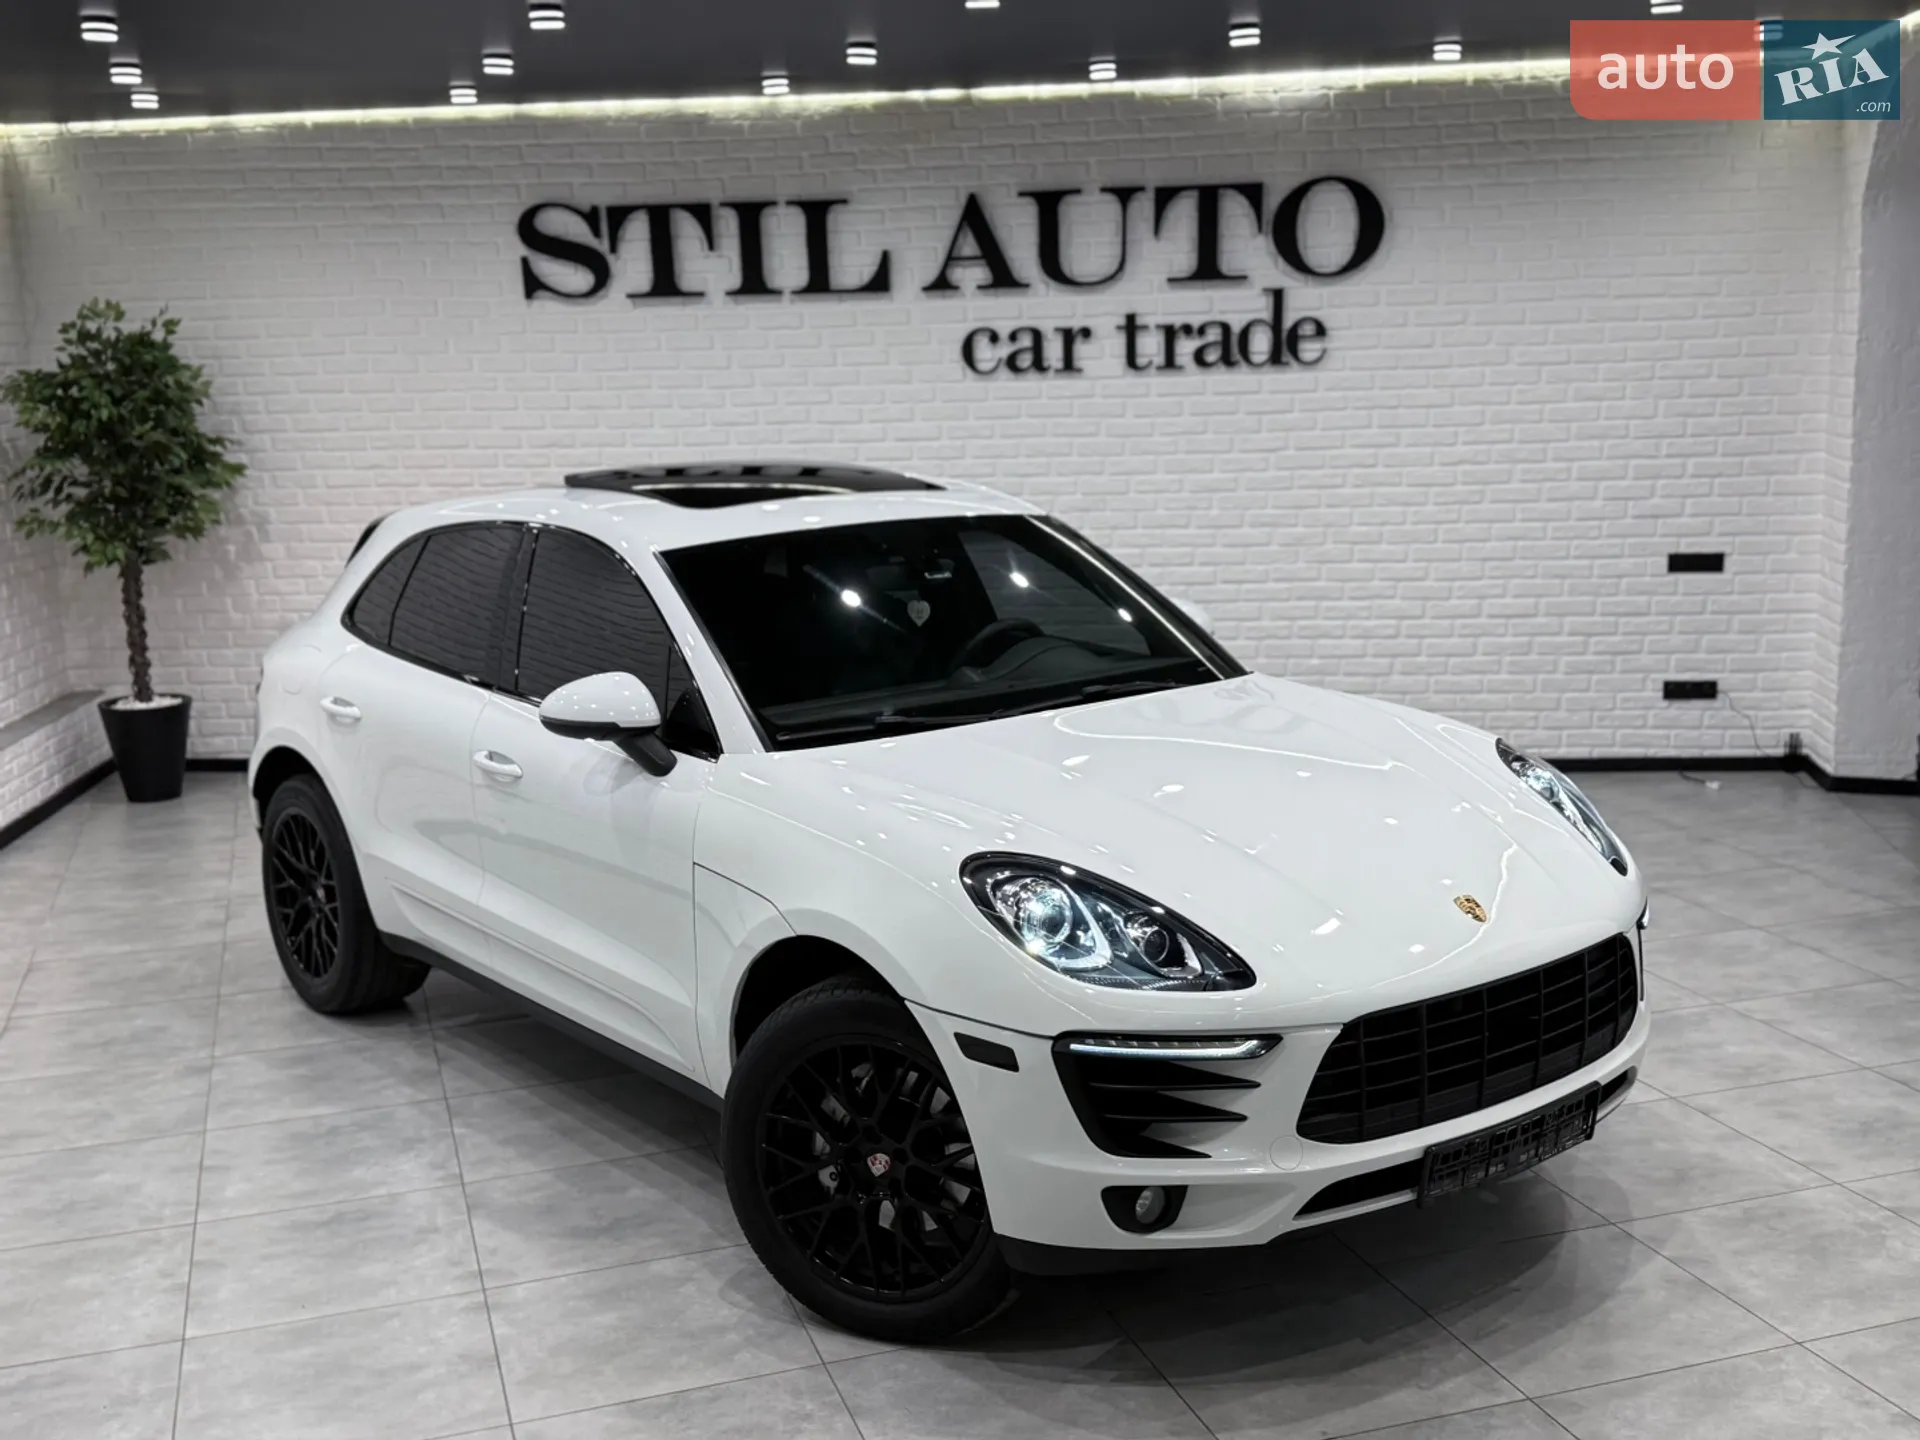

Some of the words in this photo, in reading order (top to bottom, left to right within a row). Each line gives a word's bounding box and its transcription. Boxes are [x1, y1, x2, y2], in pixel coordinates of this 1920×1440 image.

[517, 198, 891, 299] STIL
[921, 175, 1386, 292] AUTO
[962, 325, 1092, 375] car
[1115, 288, 1329, 372] trade
